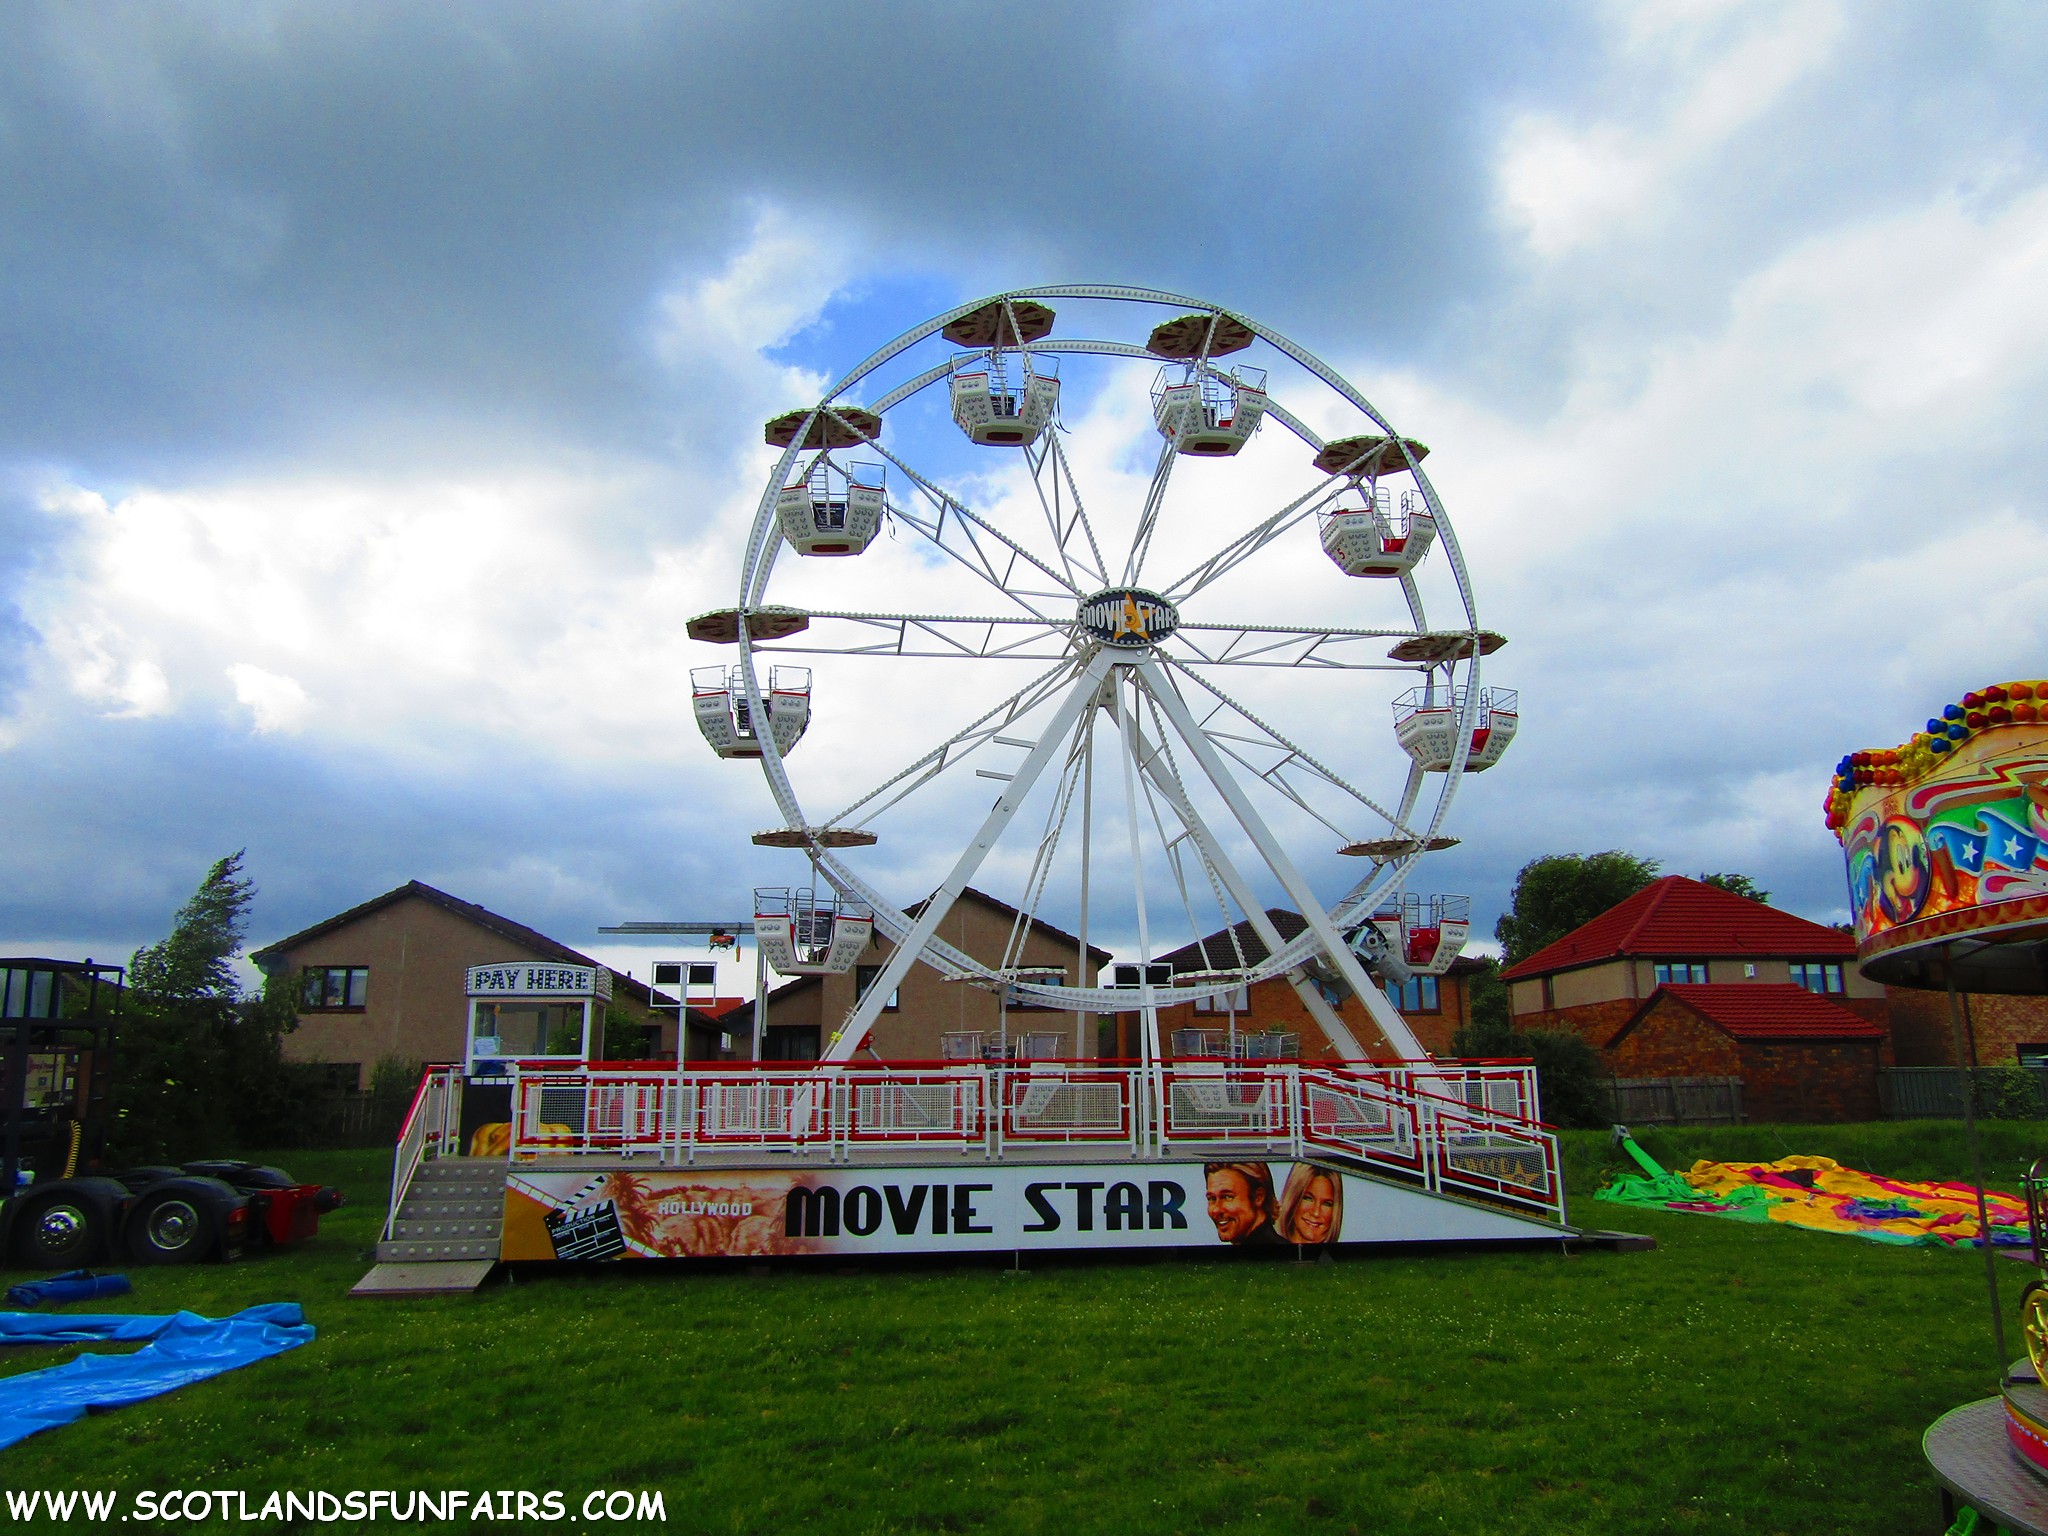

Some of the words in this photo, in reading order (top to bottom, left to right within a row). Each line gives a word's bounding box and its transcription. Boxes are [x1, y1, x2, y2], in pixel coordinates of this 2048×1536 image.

[1083, 599, 1131, 633] MOVIE
[1135, 600, 1175, 633] STAR
[474, 968, 521, 990] PAY
[526, 968, 590, 990] HERE
[658, 1201, 753, 1217] HOLLYWOOD
[784, 1182, 995, 1239] MOVIE
[1022, 1179, 1189, 1235] STAR
[551, 1214, 596, 1235] PRODUCTION
